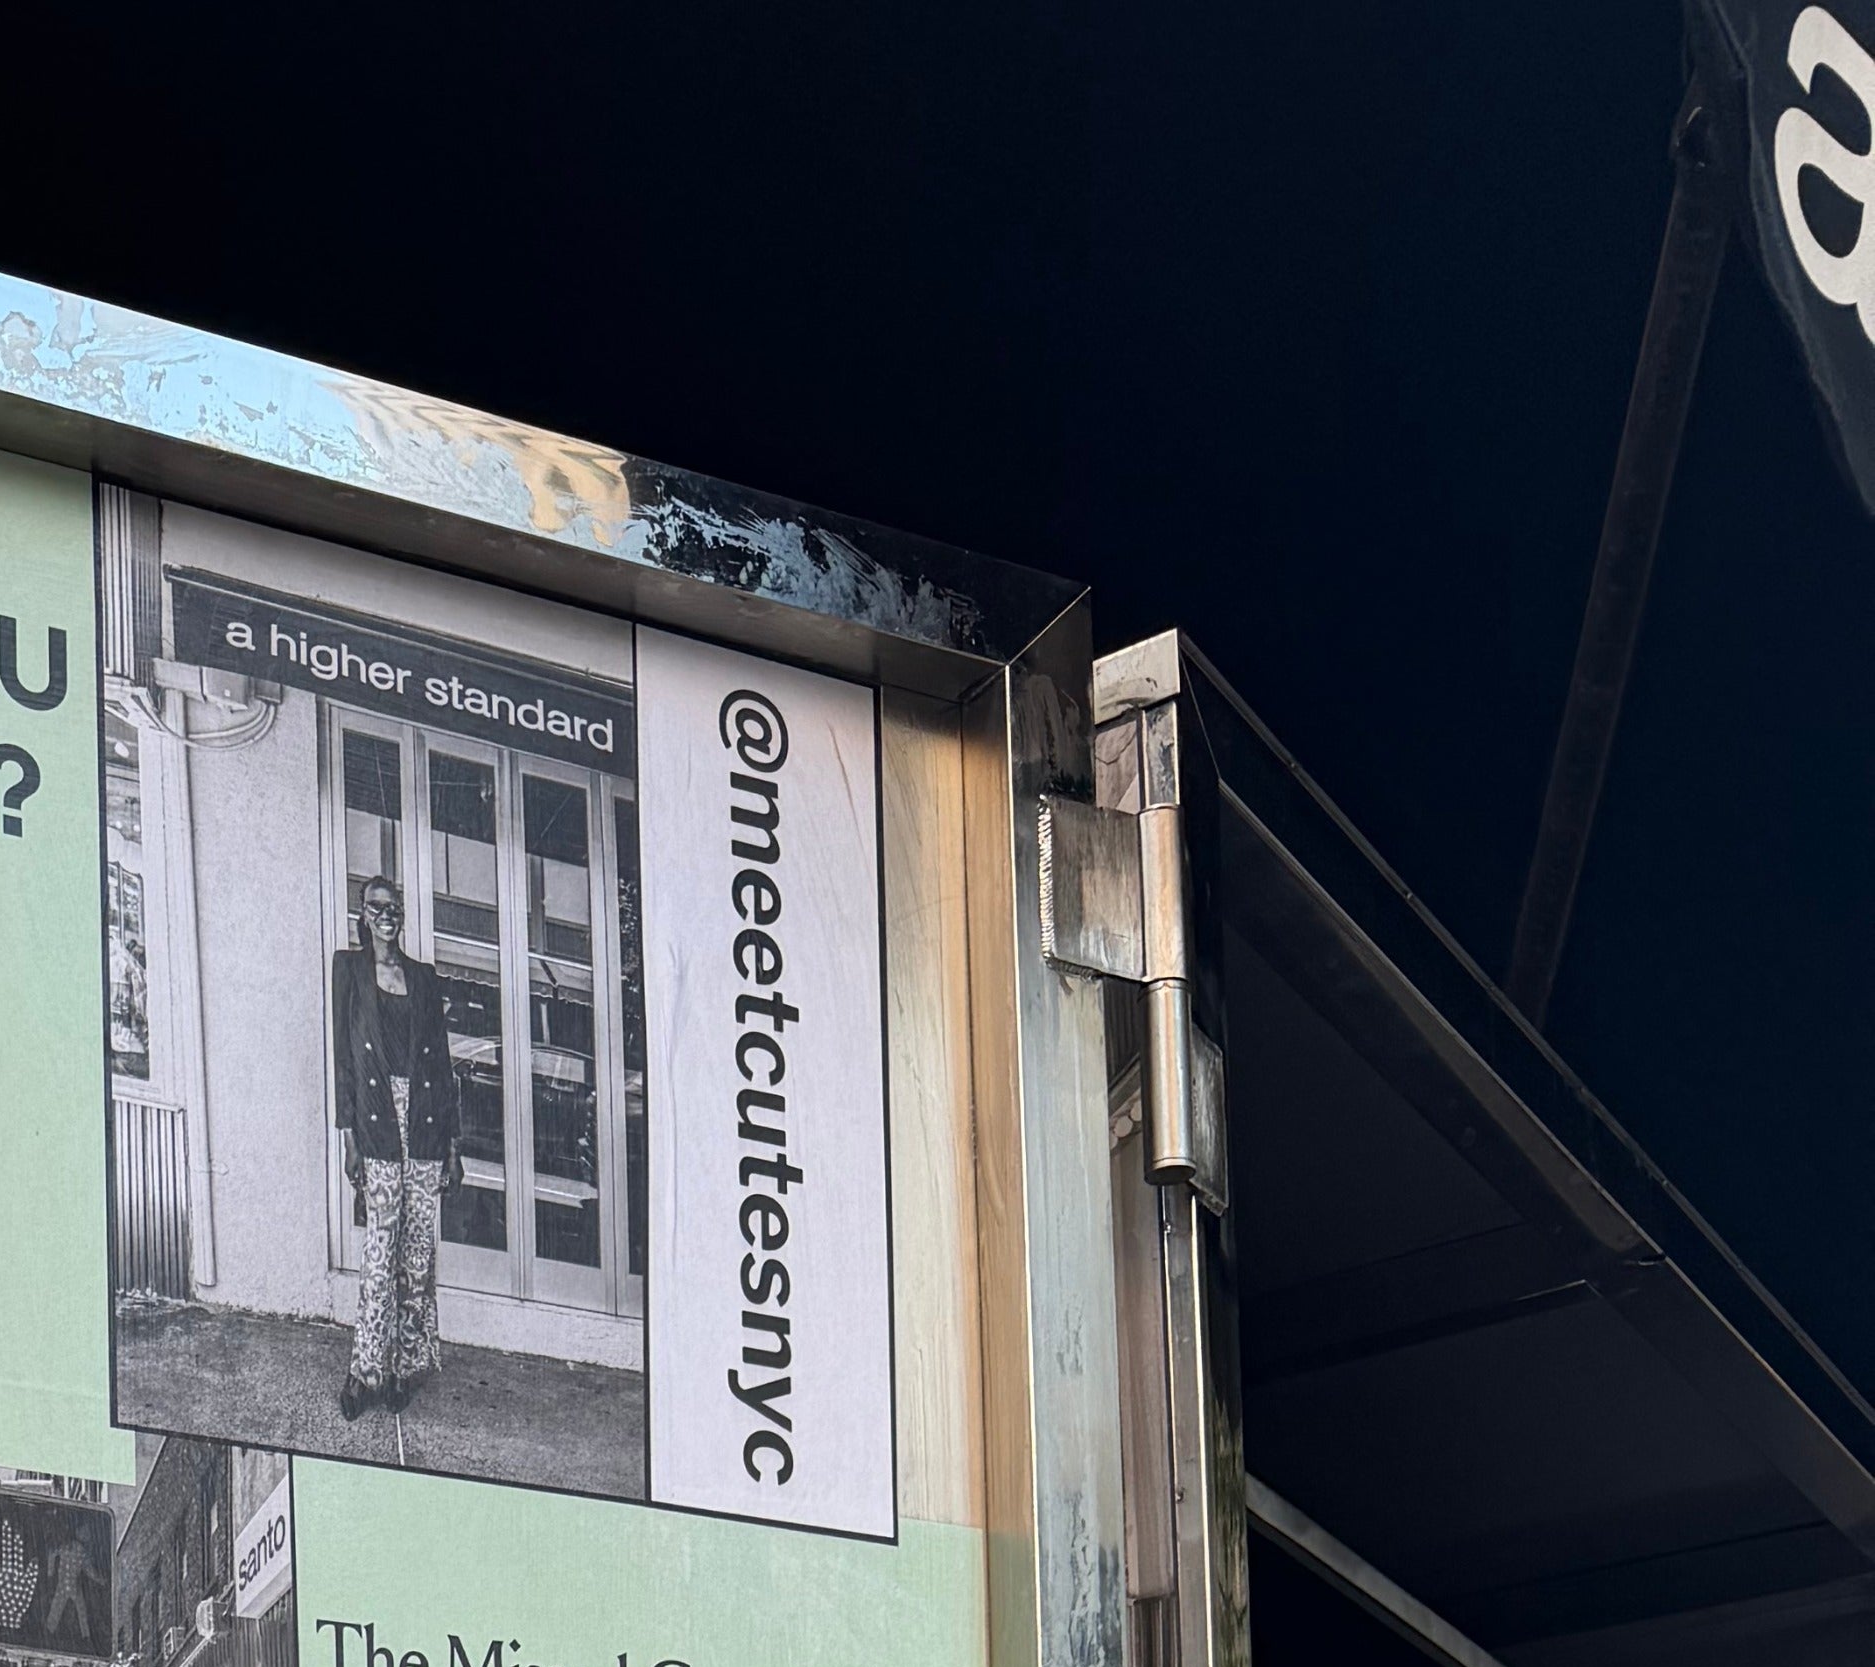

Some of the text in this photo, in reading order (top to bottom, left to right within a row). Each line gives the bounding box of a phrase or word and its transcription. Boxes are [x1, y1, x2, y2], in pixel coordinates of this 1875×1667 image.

[225, 621, 614, 753] a higher standard
[719, 689, 804, 1486] @meetcutesnyc
[238, 1514, 286, 1592] santo
